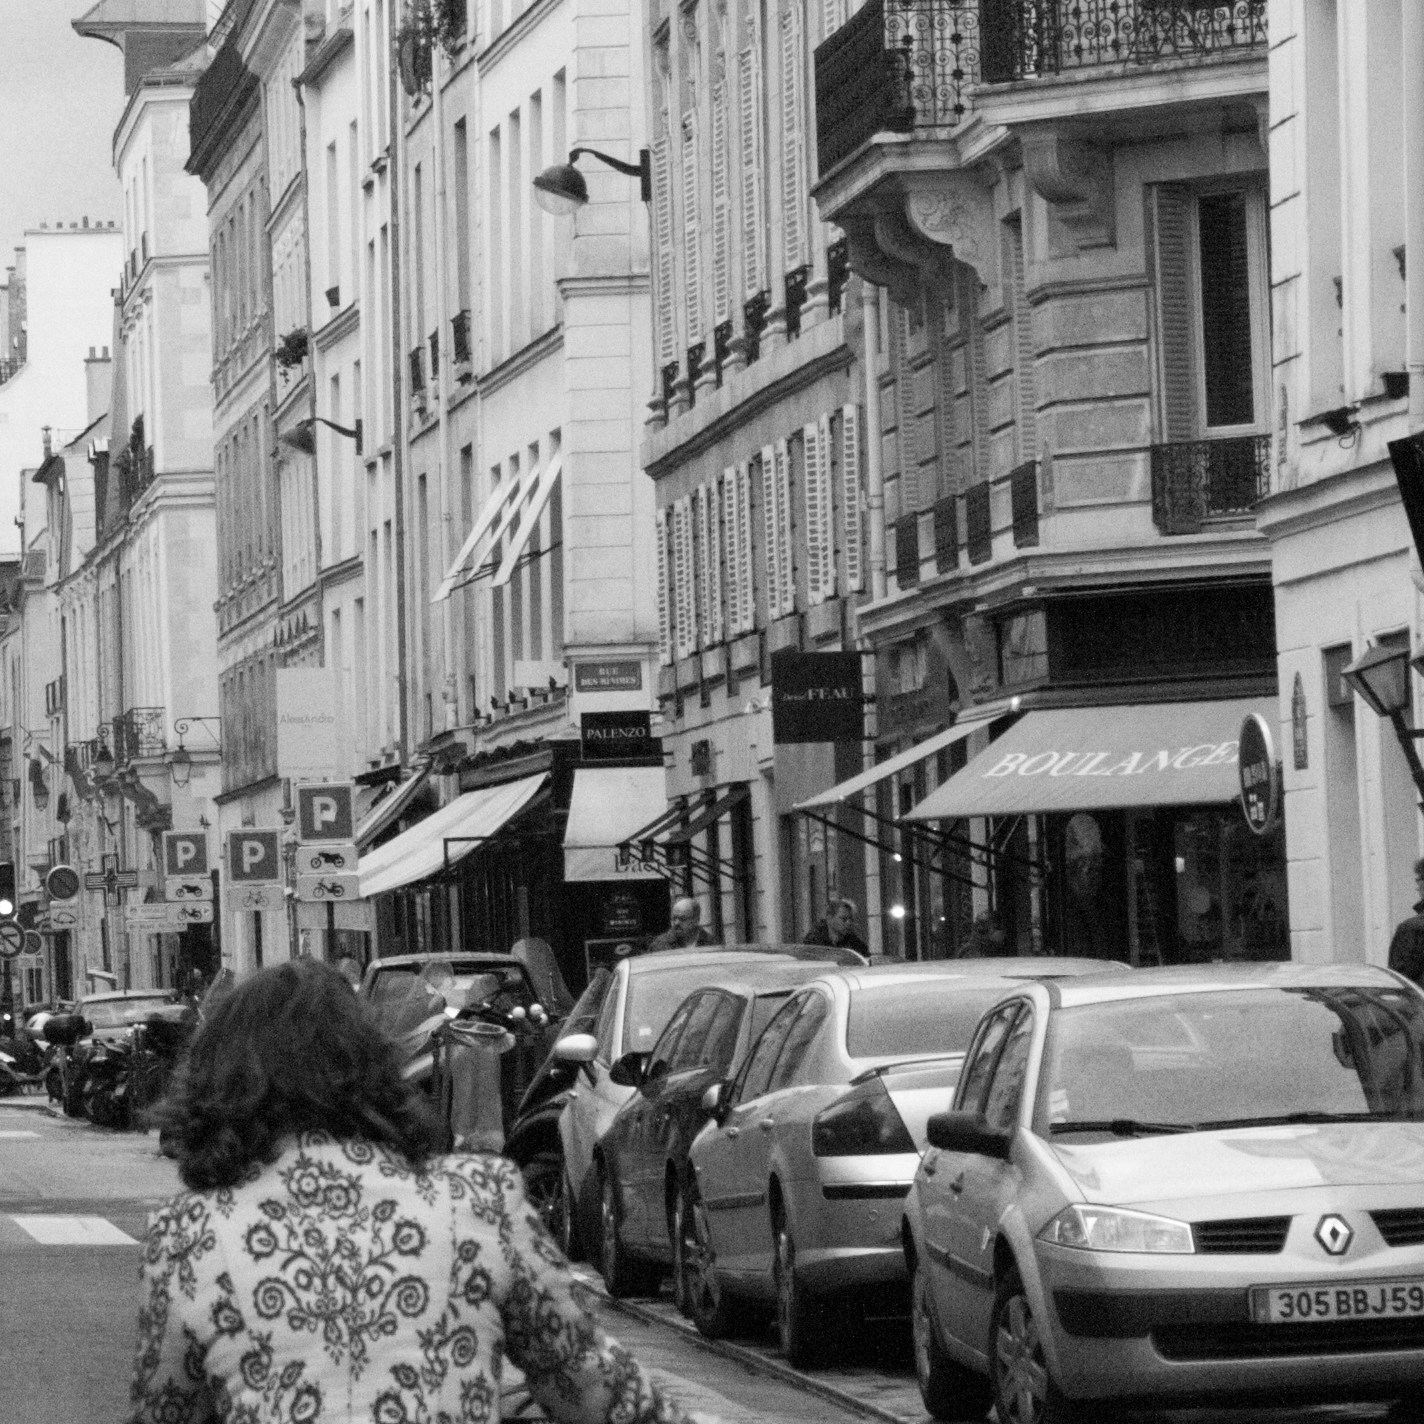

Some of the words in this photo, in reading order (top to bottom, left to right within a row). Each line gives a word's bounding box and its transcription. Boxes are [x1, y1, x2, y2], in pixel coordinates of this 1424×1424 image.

[580, 677, 598, 686] DES
[598, 667, 619, 676] RUE
[586, 726, 646, 740] PALENZO
[984, 740, 1239, 777] BOULANGE
[312, 796, 339, 831] P
[177, 840, 196, 869] P
[242, 840, 266, 873] P
[1278, 1290, 1330, 1318] 305
[1335, 1287, 1387, 1316] BBJ
[1391, 1285, 1424, 1313] 59
